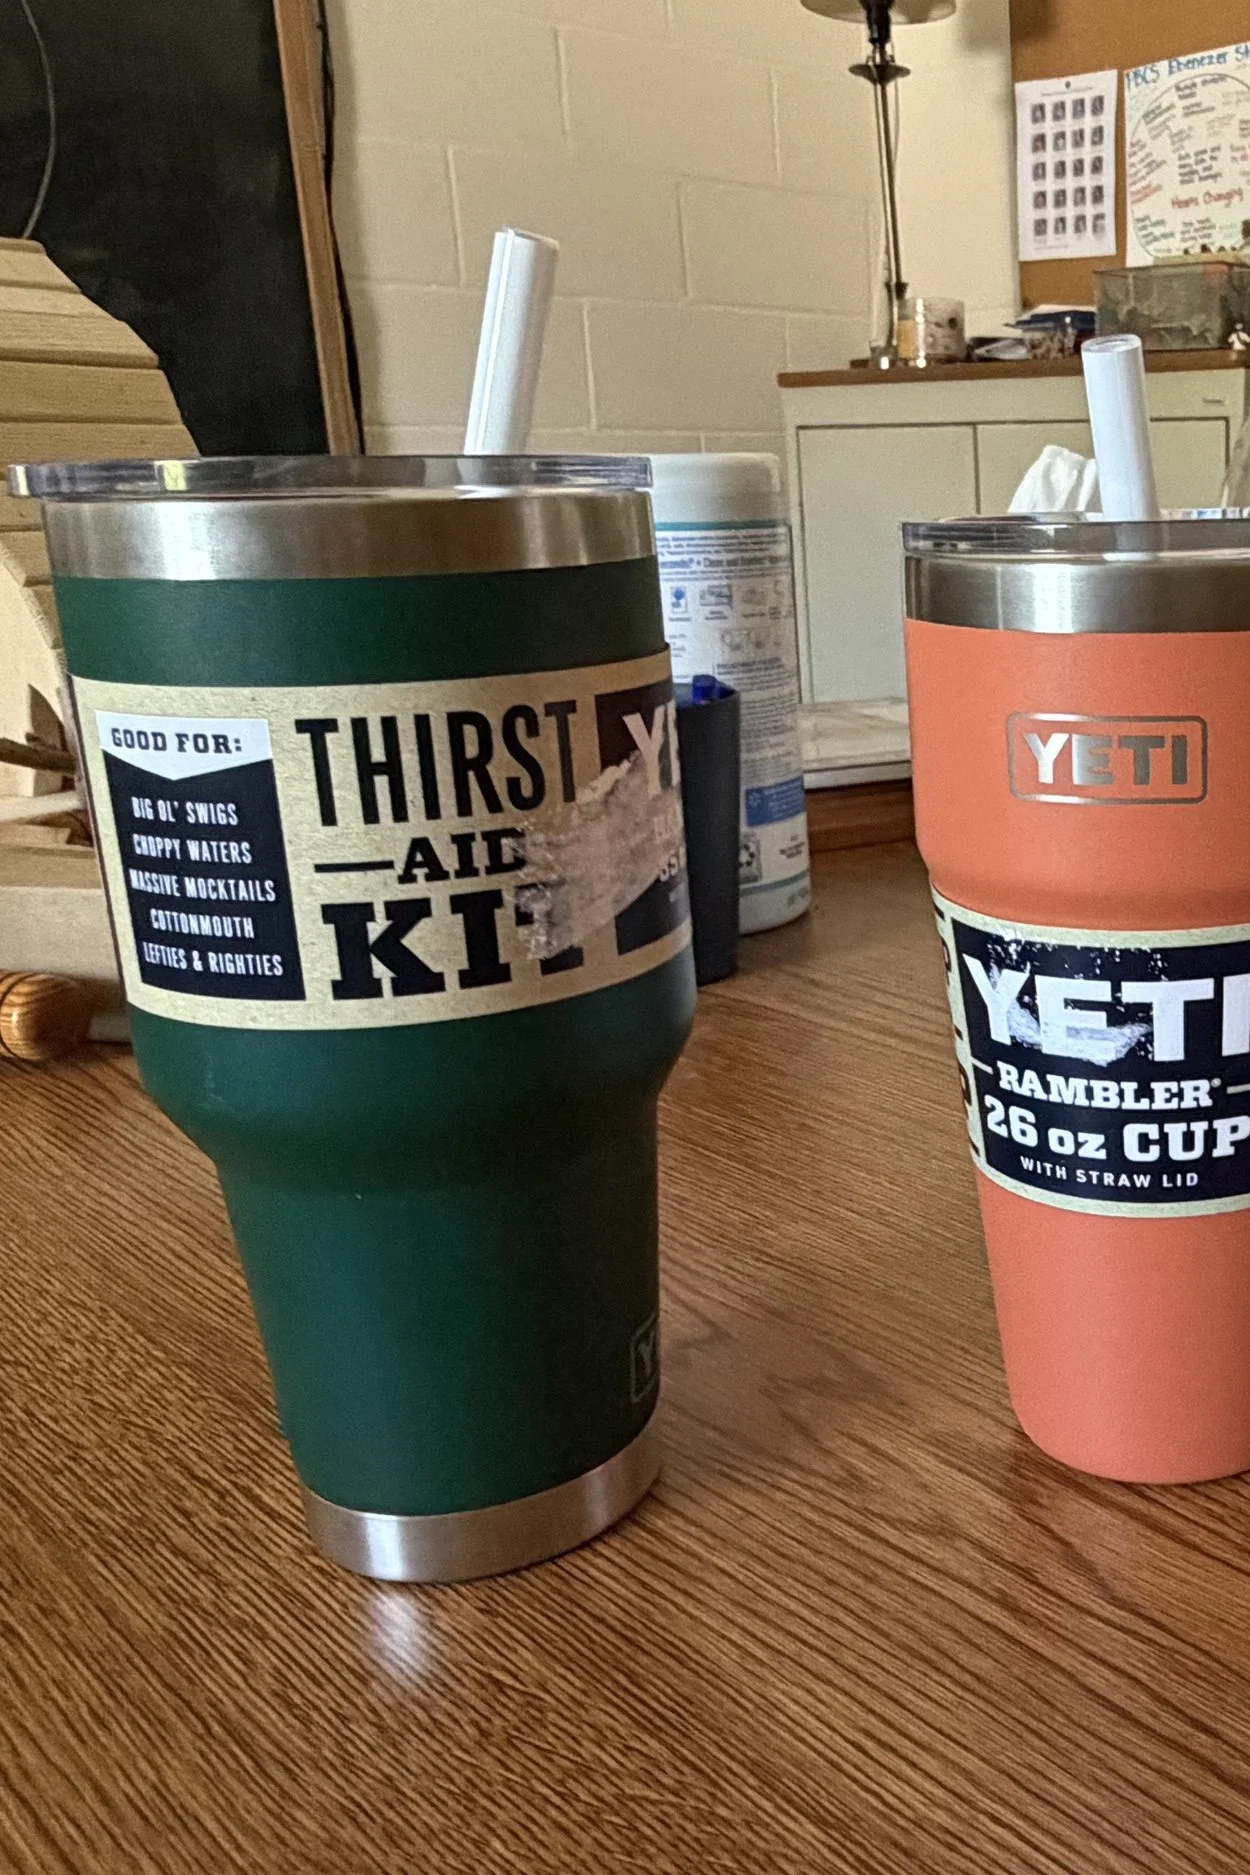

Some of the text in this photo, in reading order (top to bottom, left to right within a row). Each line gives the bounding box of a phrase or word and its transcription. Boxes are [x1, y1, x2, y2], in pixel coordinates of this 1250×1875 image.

[111, 728, 242, 754] GOOD FOR:
[1024, 733, 1188, 785] YETI
[131, 796, 154, 820] BIG
[186, 802, 238, 825] SWIGS
[133, 834, 252, 864] CHOPPY WATERS
[128, 868, 276, 902] MASSIVE MOCKTAILS
[150, 908, 255, 938] COTTONMOUTH
[143, 941, 284, 976] LEFTIES & RIGHTIES
[984, 1095, 1038, 1148] 26
[1048, 1129, 1107, 1160] oz
[1020, 1157, 1199, 1188] WITH STRAW LID
